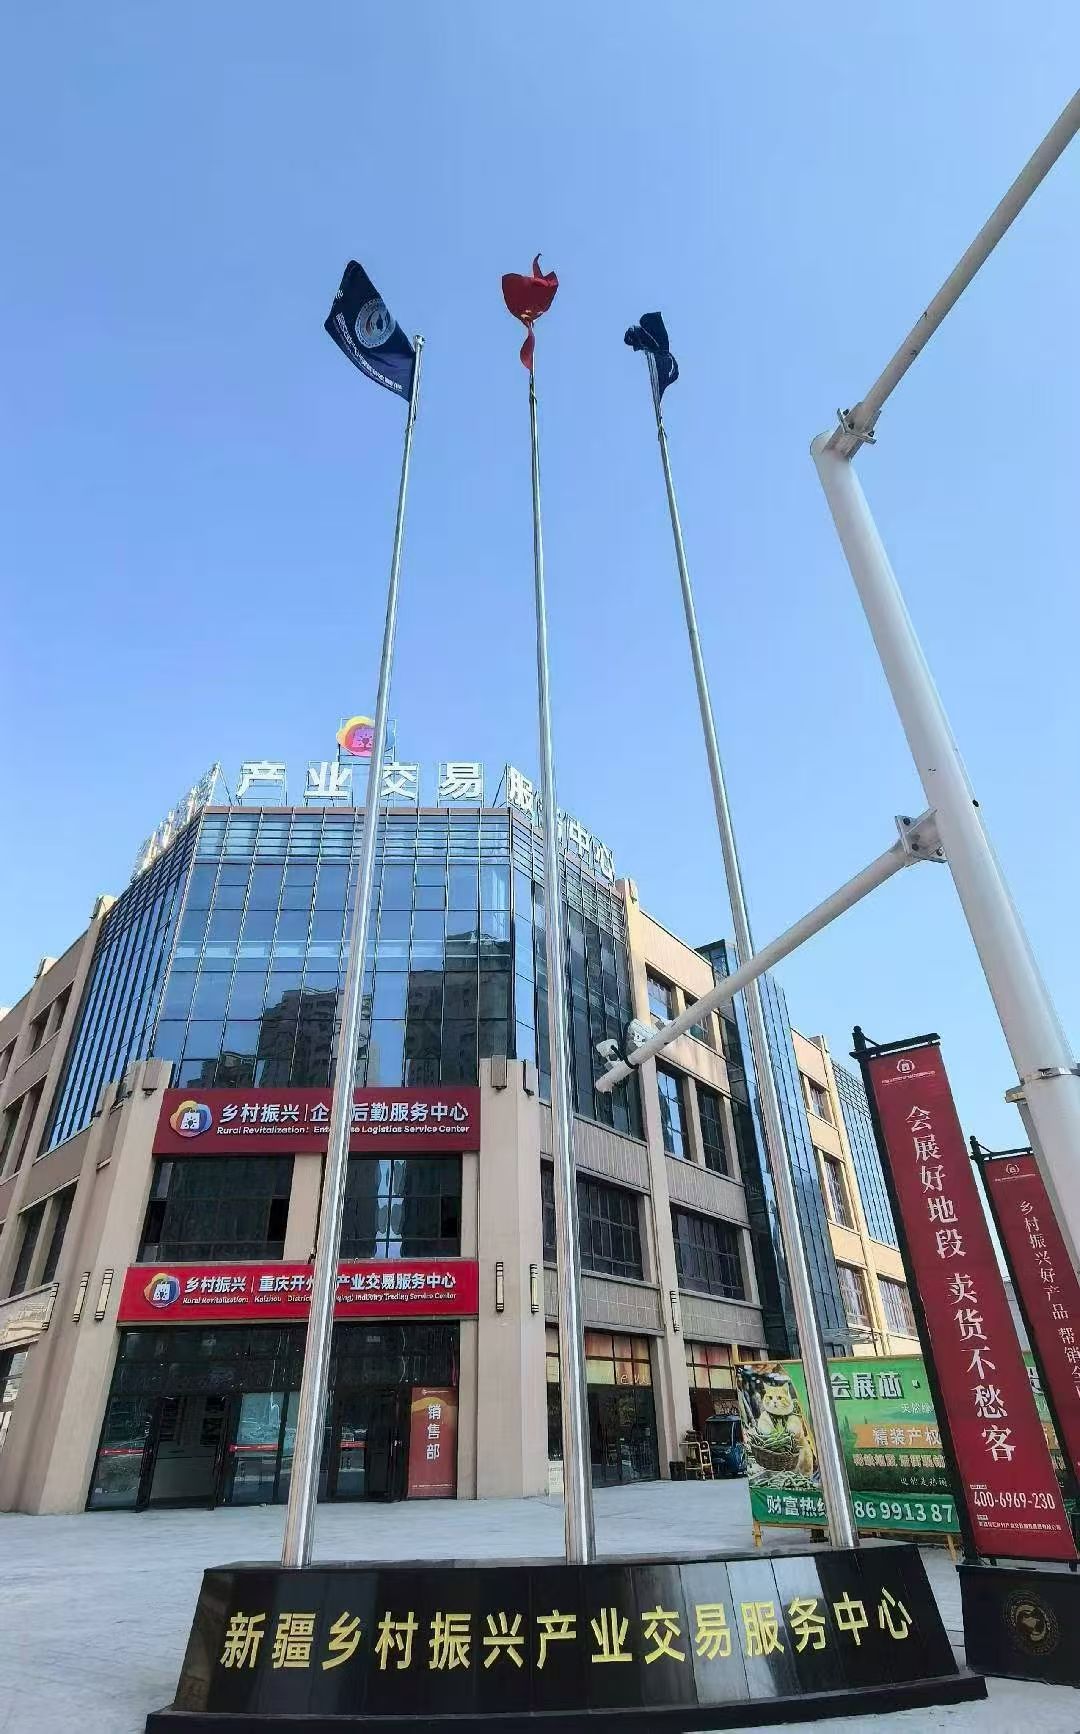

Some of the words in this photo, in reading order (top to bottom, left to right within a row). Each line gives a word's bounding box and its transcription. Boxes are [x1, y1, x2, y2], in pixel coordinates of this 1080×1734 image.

[220, 1103, 299, 1123] 乡村振兴
[217, 1126, 241, 1135] Rural
[404, 1125, 437, 1133] Service
[439, 1125, 470, 1133] Center
[184, 1276, 247, 1293] 乡村振兴
[973, 1491, 1056, 1510] 400-6969-230
[219, 1586, 913, 1671] 新疆乡村振兴产业交易服务中心
